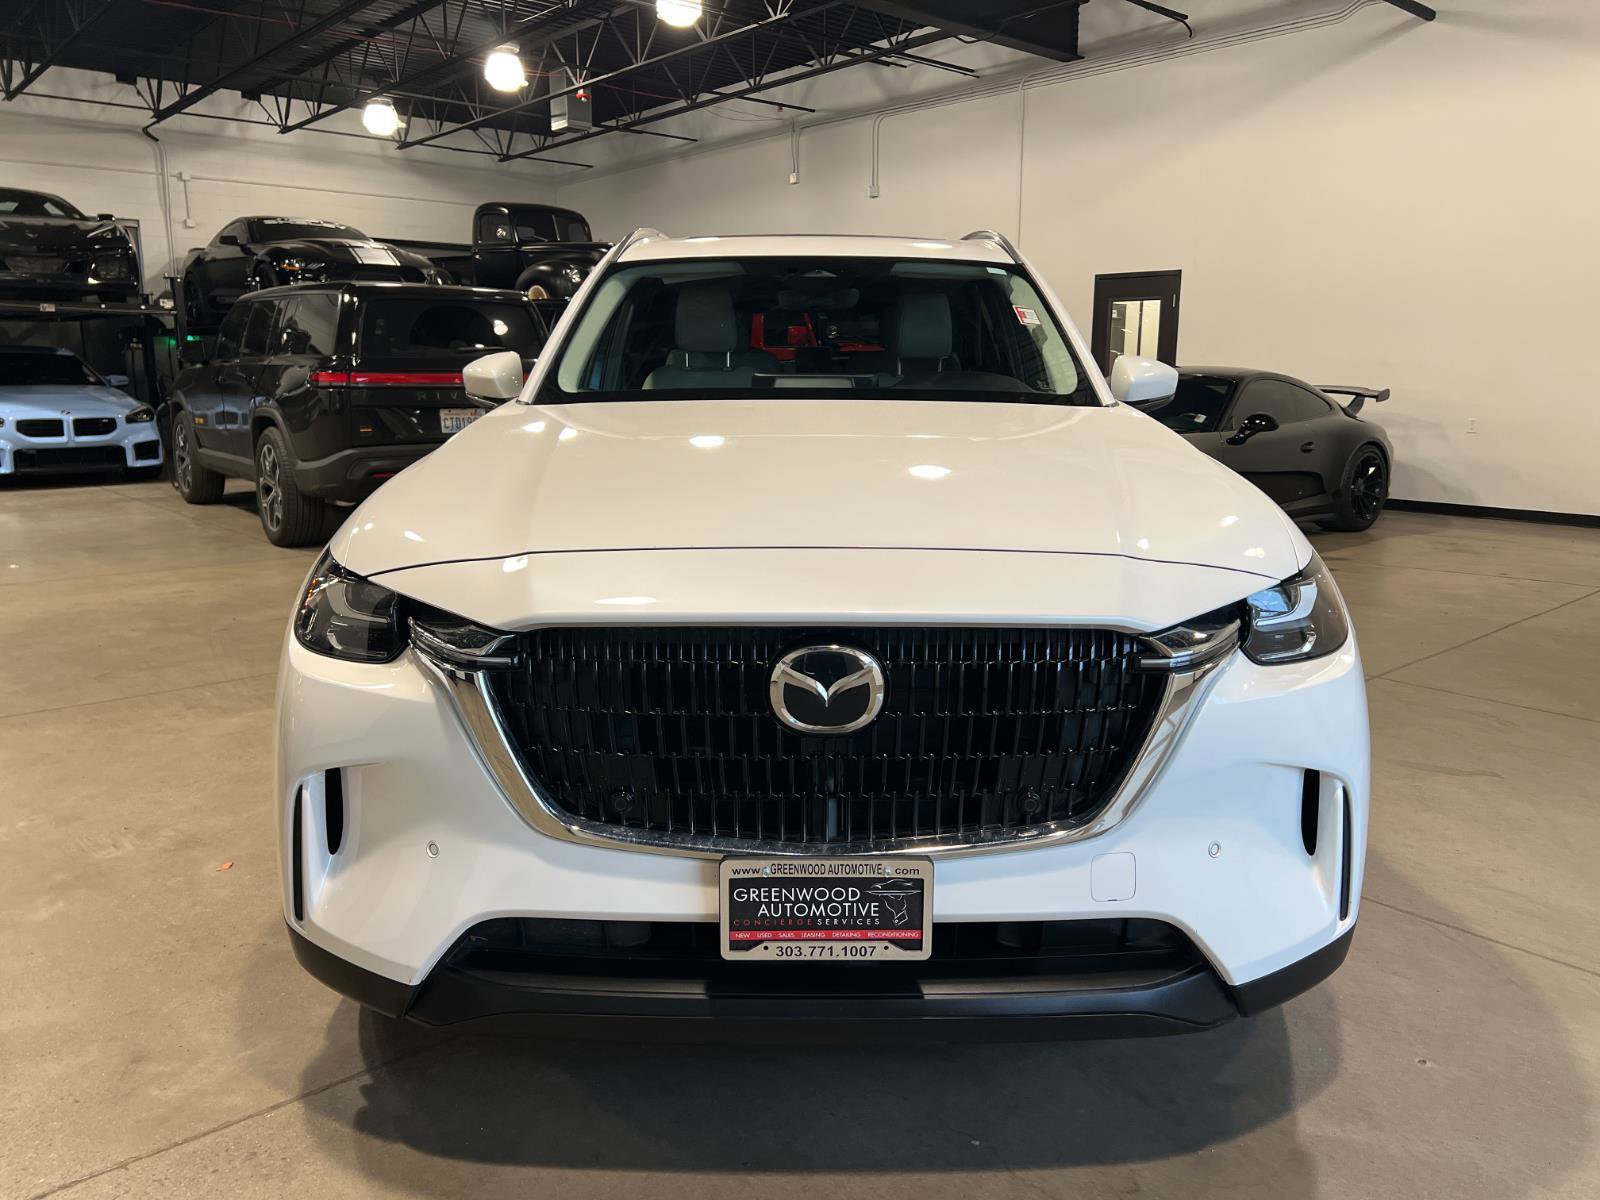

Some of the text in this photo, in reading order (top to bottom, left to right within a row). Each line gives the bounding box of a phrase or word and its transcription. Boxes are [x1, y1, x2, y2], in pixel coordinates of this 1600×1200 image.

[770, 863, 825, 875] GREENWOOD
[827, 863, 882, 875] AUTOMOTIVE
[894, 867, 920, 875] com
[733, 887, 861, 902] GREENWOOD
[757, 902, 880, 918] AUTOMOTIVE
[817, 918, 880, 926] SERVICES
[775, 945, 877, 957] 303.771.1007
